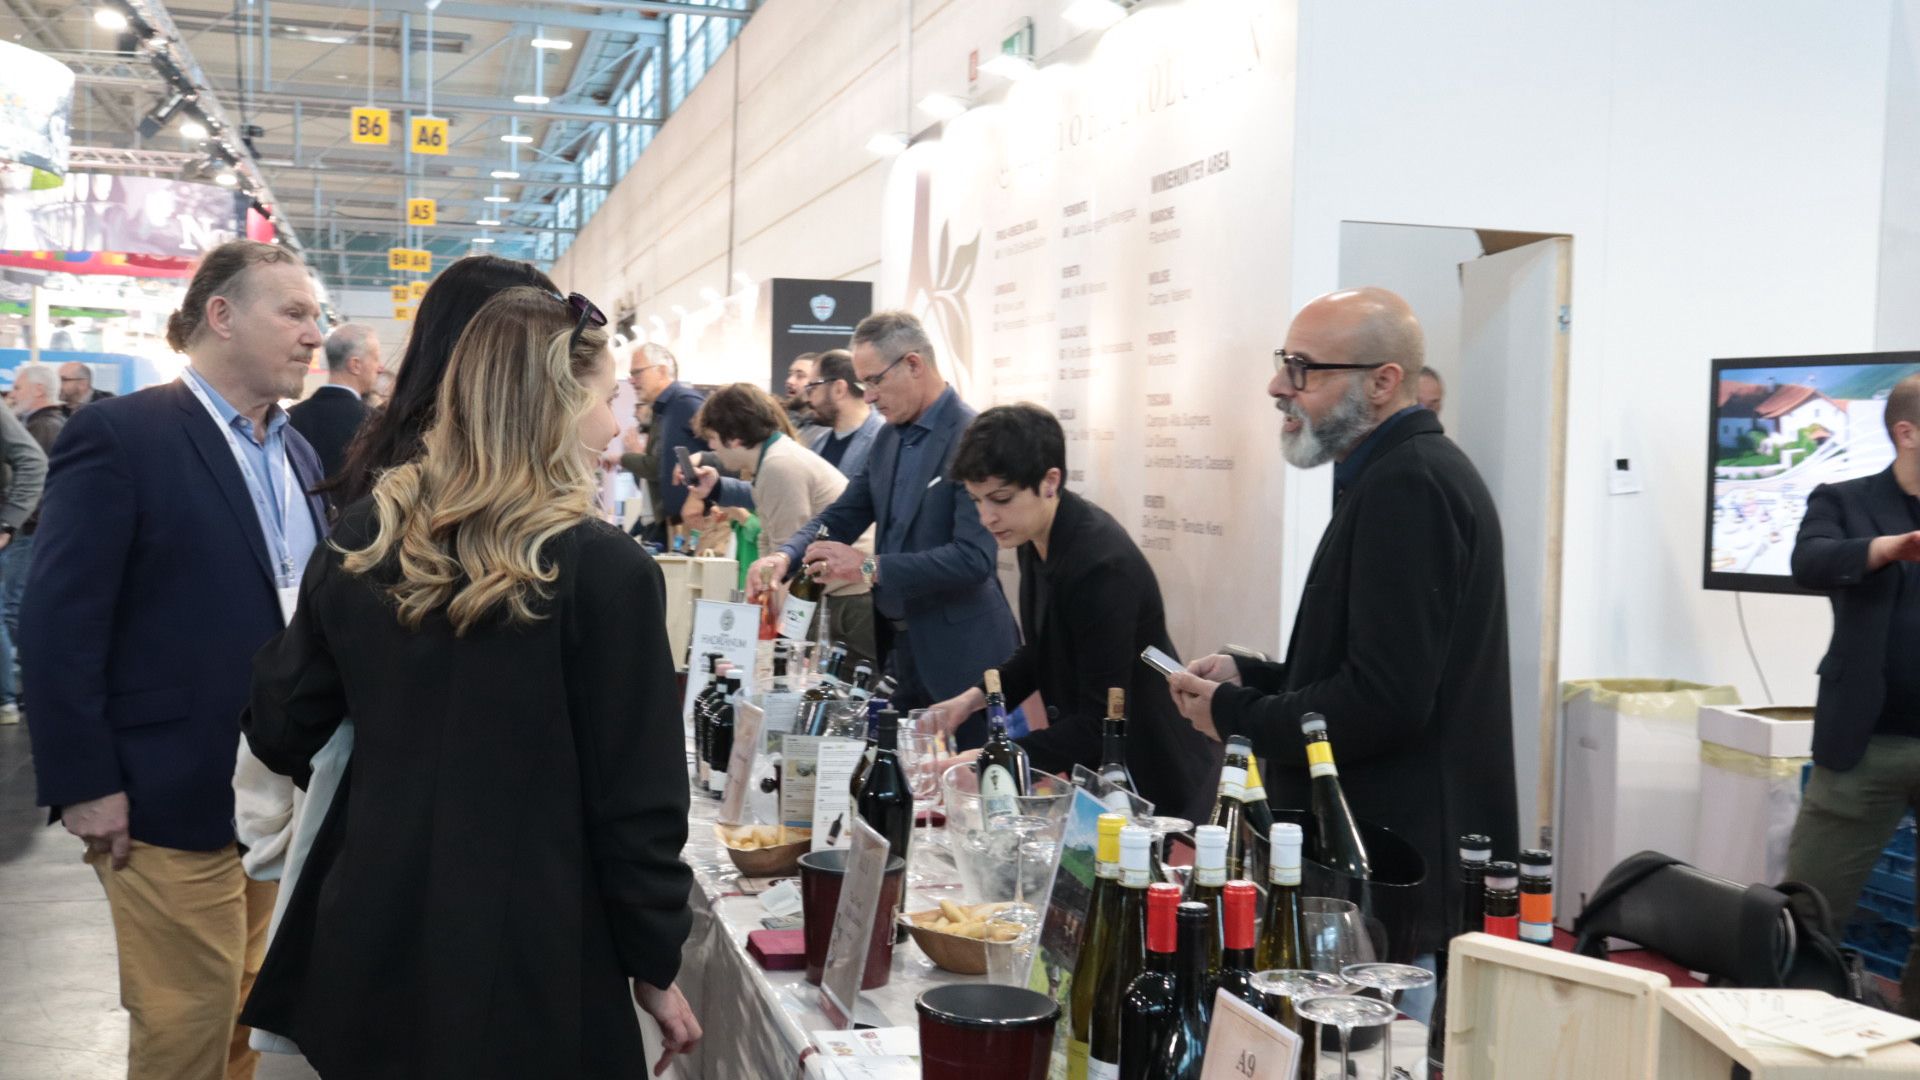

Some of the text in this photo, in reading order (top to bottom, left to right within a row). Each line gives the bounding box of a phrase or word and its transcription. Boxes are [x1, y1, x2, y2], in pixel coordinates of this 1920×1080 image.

[358, 116, 383, 137] B6
[417, 126, 442, 147] A6
[1207, 149, 1231, 175] AREA
[412, 205, 430, 219] A5
[1235, 1049, 1256, 1078] A9
